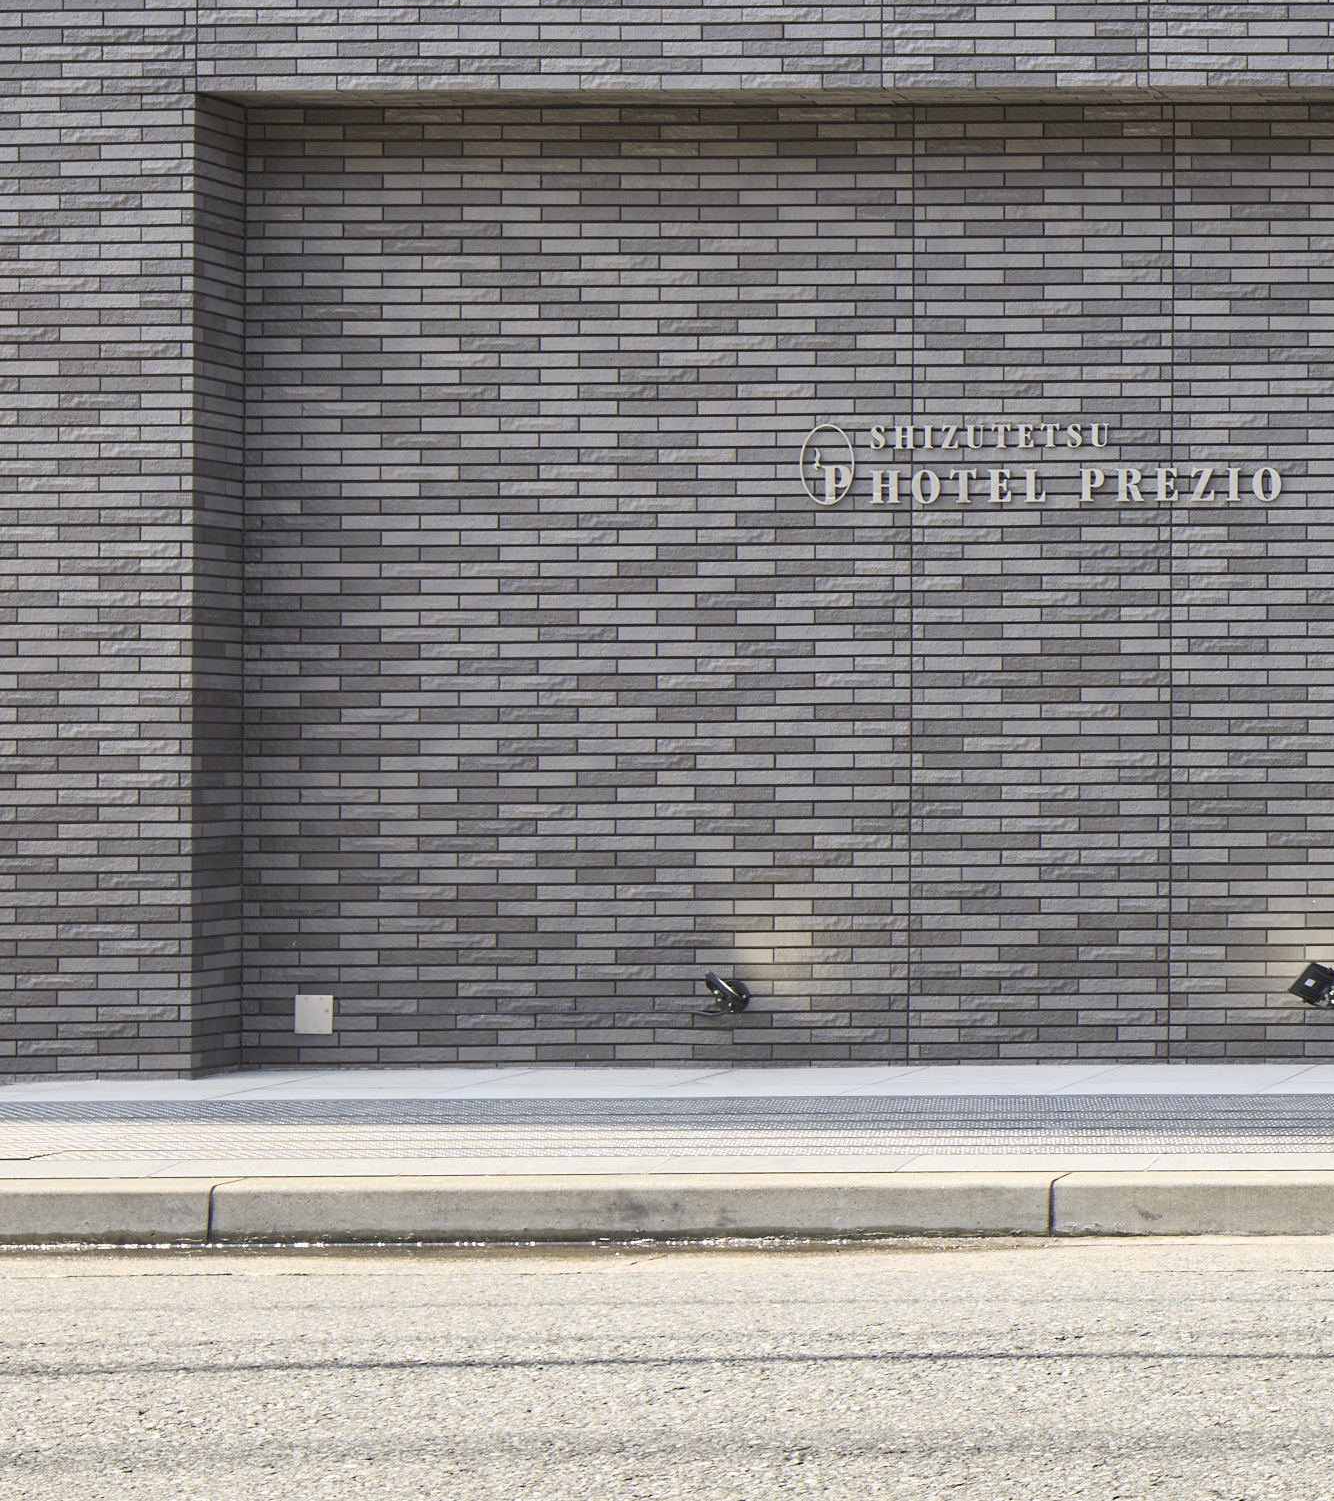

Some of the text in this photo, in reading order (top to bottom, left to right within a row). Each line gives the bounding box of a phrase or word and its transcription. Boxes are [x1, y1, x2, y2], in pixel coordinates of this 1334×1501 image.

[869, 422, 1111, 450] SHIZUTETSU
[869, 465, 1284, 505] HOTEL PREZIO
